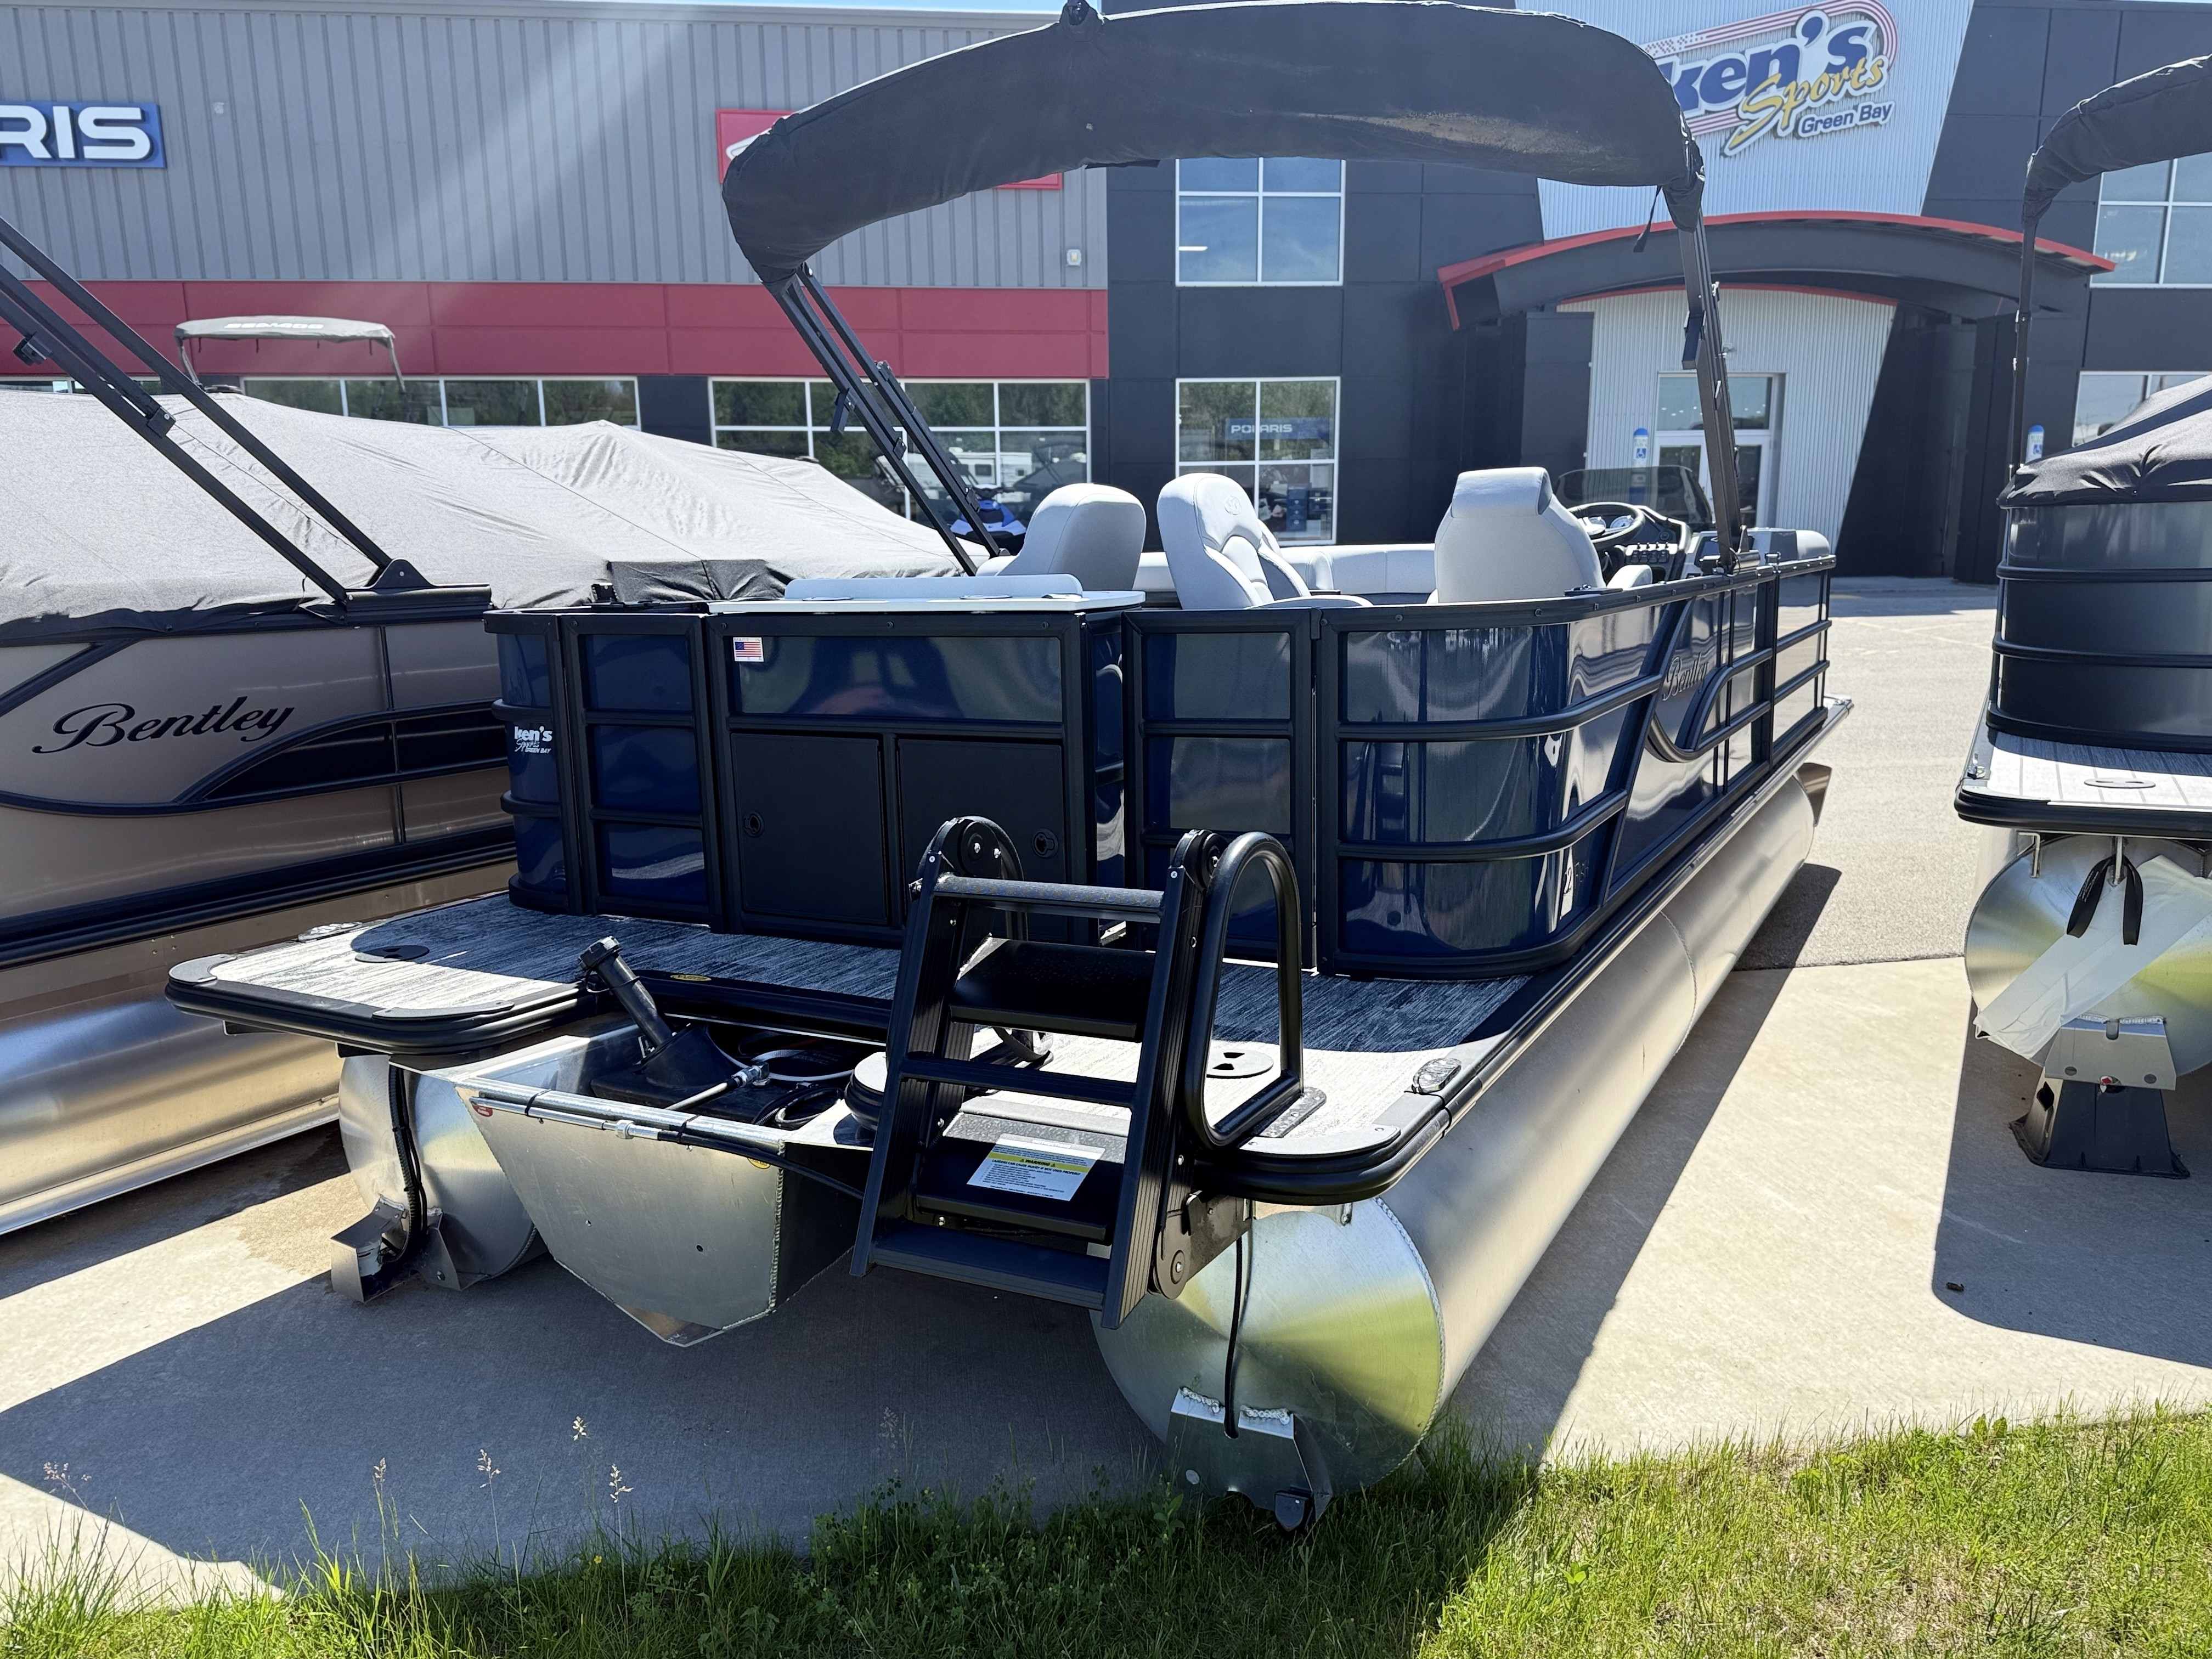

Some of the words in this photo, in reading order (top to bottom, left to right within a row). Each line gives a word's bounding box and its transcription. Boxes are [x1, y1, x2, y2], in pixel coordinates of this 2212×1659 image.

[1729, 57, 1884, 148] Sports
[1801, 110, 1854, 134] Green
[1858, 103, 1892, 124] Bay
[31, 696, 295, 754] Bentley
[514, 726, 553, 742] ken's
